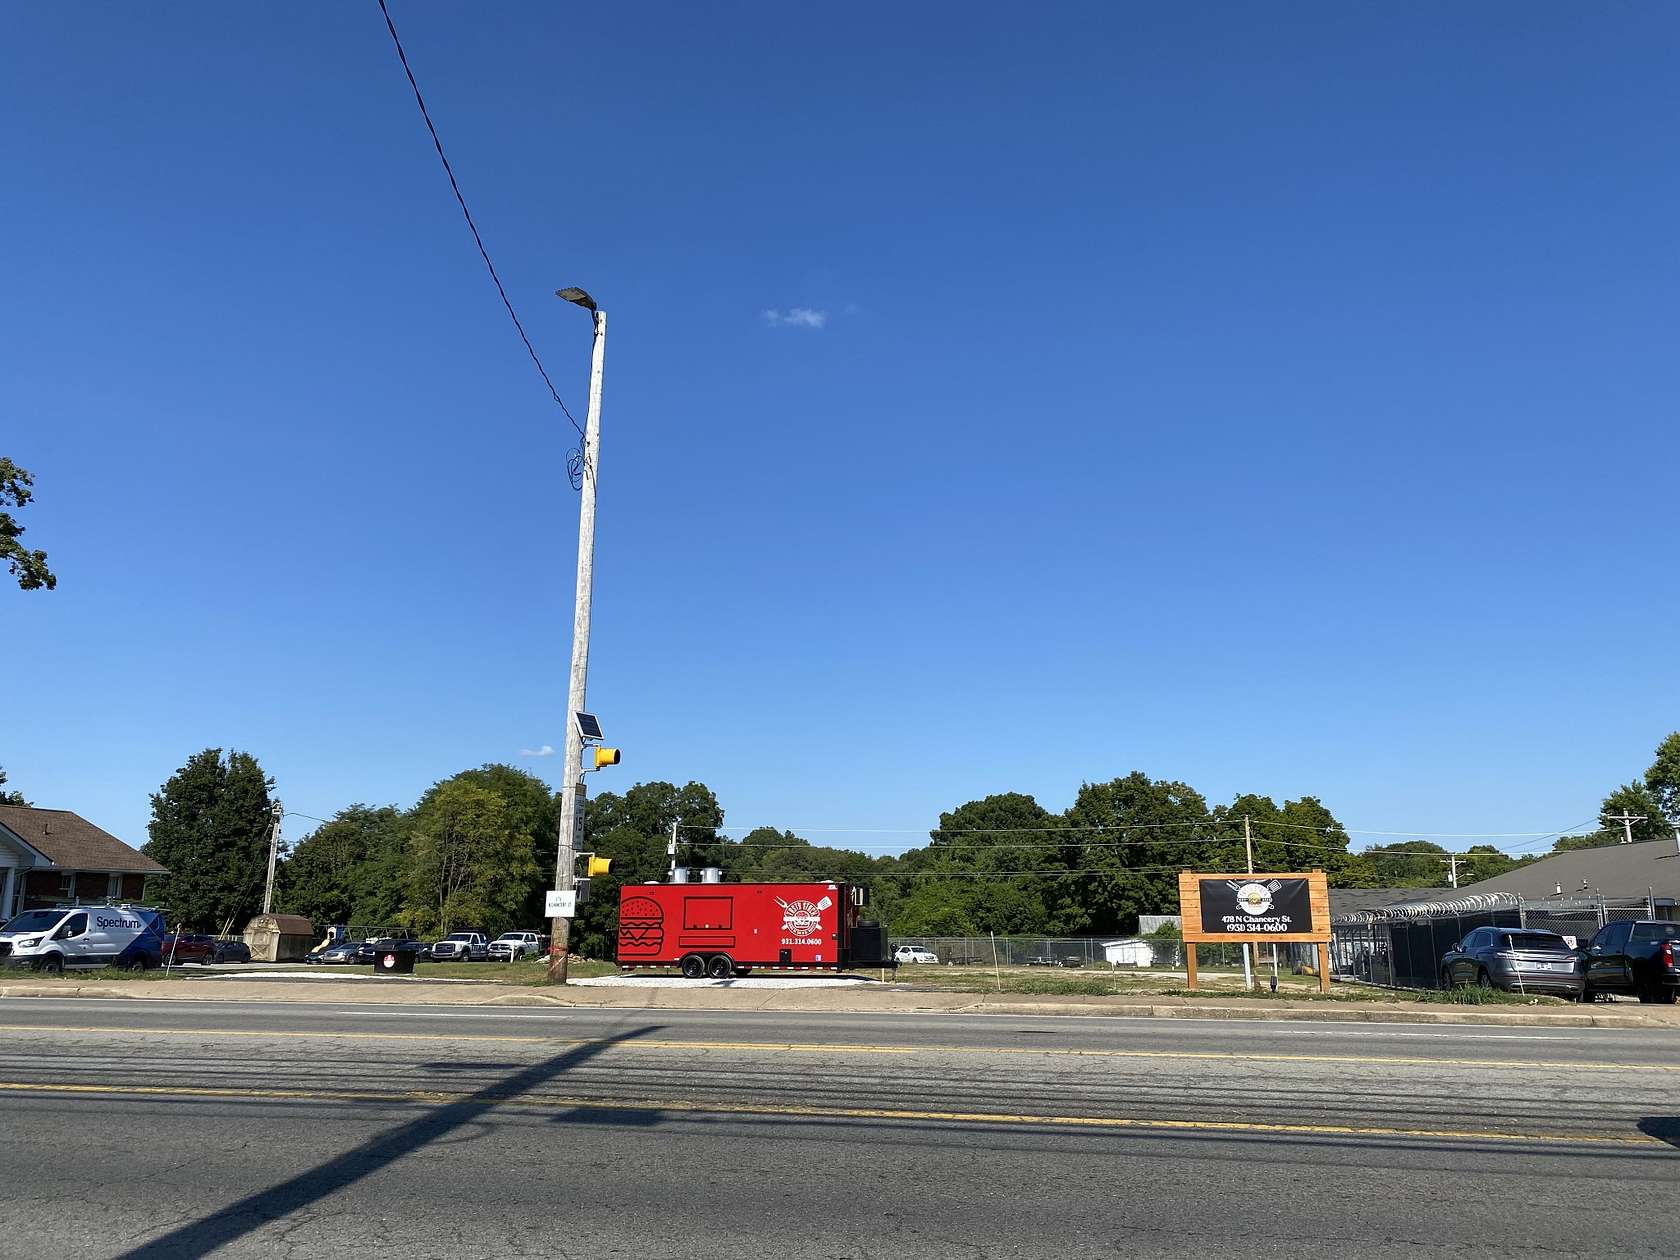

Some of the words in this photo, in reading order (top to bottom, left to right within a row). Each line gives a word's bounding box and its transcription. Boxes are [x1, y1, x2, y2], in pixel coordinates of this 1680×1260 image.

[575, 816, 583, 832] 15
[96, 916, 139, 930] Spectrum
[1221, 915, 1235, 923] 478
[1235, 915, 1243, 923] N
[1243, 915, 1281, 925] Chancery
[1281, 915, 1292, 923] St.
[1226, 923, 1246, 932] (931)
[1246, 923, 1288, 932] 314-0600
